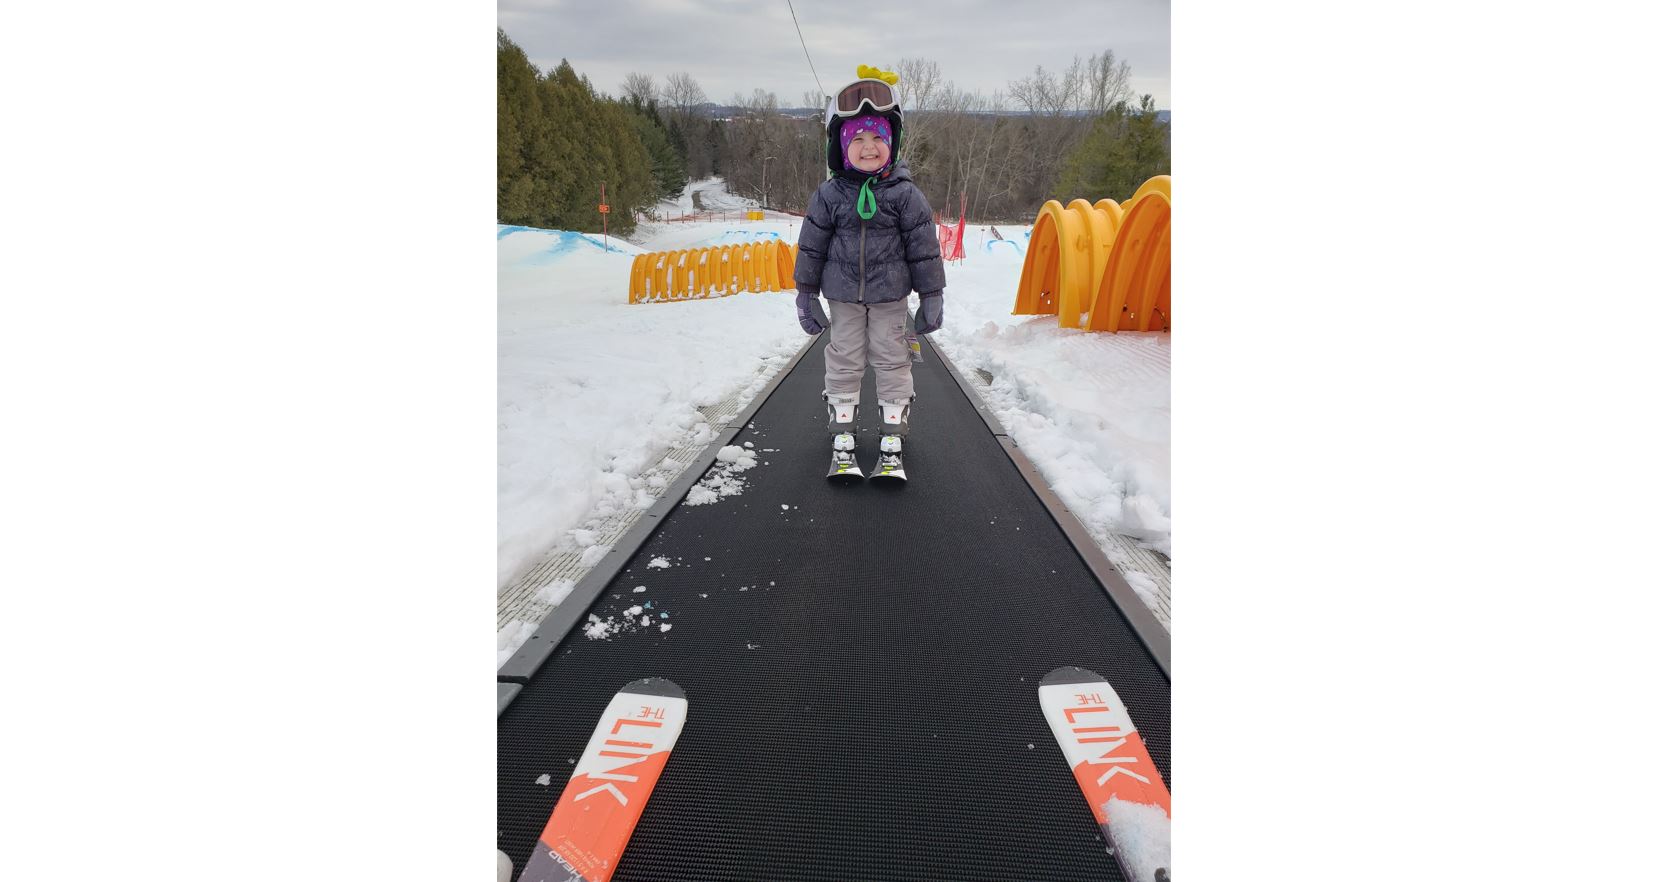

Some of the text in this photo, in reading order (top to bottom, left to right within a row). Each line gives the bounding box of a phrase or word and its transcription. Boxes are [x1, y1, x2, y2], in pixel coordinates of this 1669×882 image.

[637, 706, 665, 719] THE
[1074, 693, 1105, 705] THE
[1064, 706, 1151, 787] LINK
[573, 718, 662, 807] LINK
[548, 850, 583, 878] HEAD
